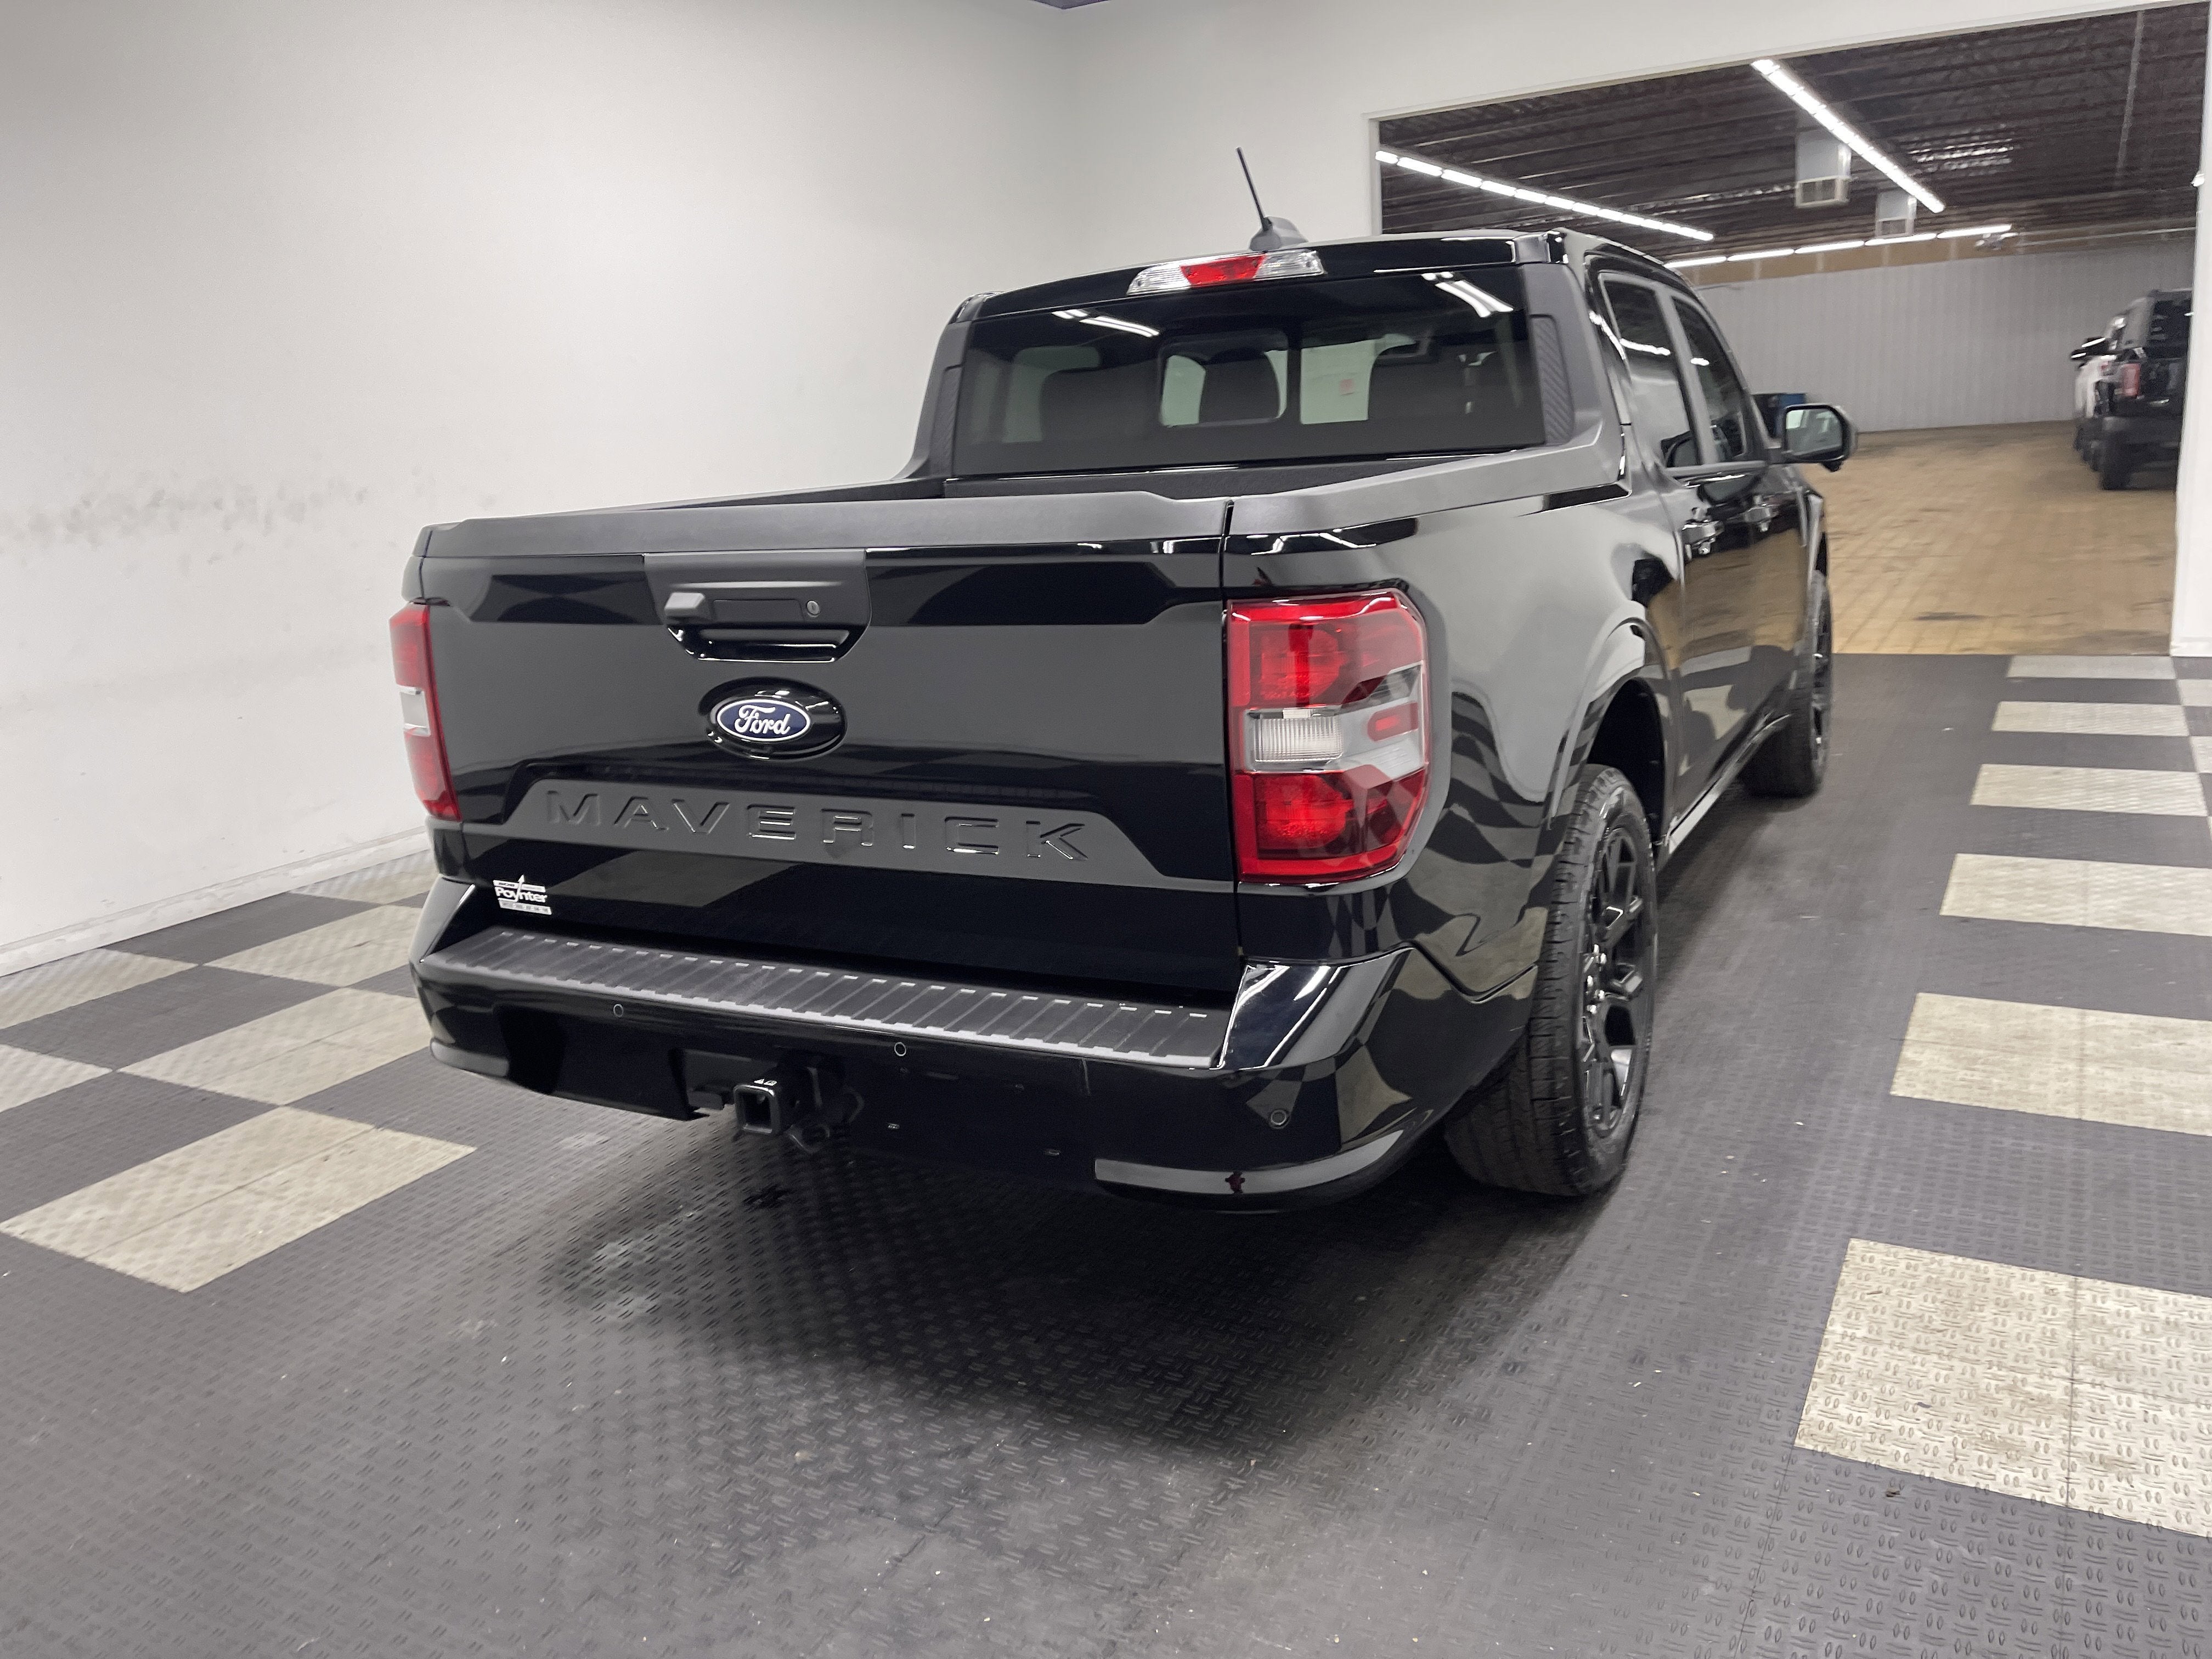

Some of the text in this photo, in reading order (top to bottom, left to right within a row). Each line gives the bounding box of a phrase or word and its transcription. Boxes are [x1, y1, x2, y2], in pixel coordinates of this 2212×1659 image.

[734, 704, 791, 735] Ford
[547, 790, 1088, 860] MAVERICK
[494, 885, 548, 903] Poynter
